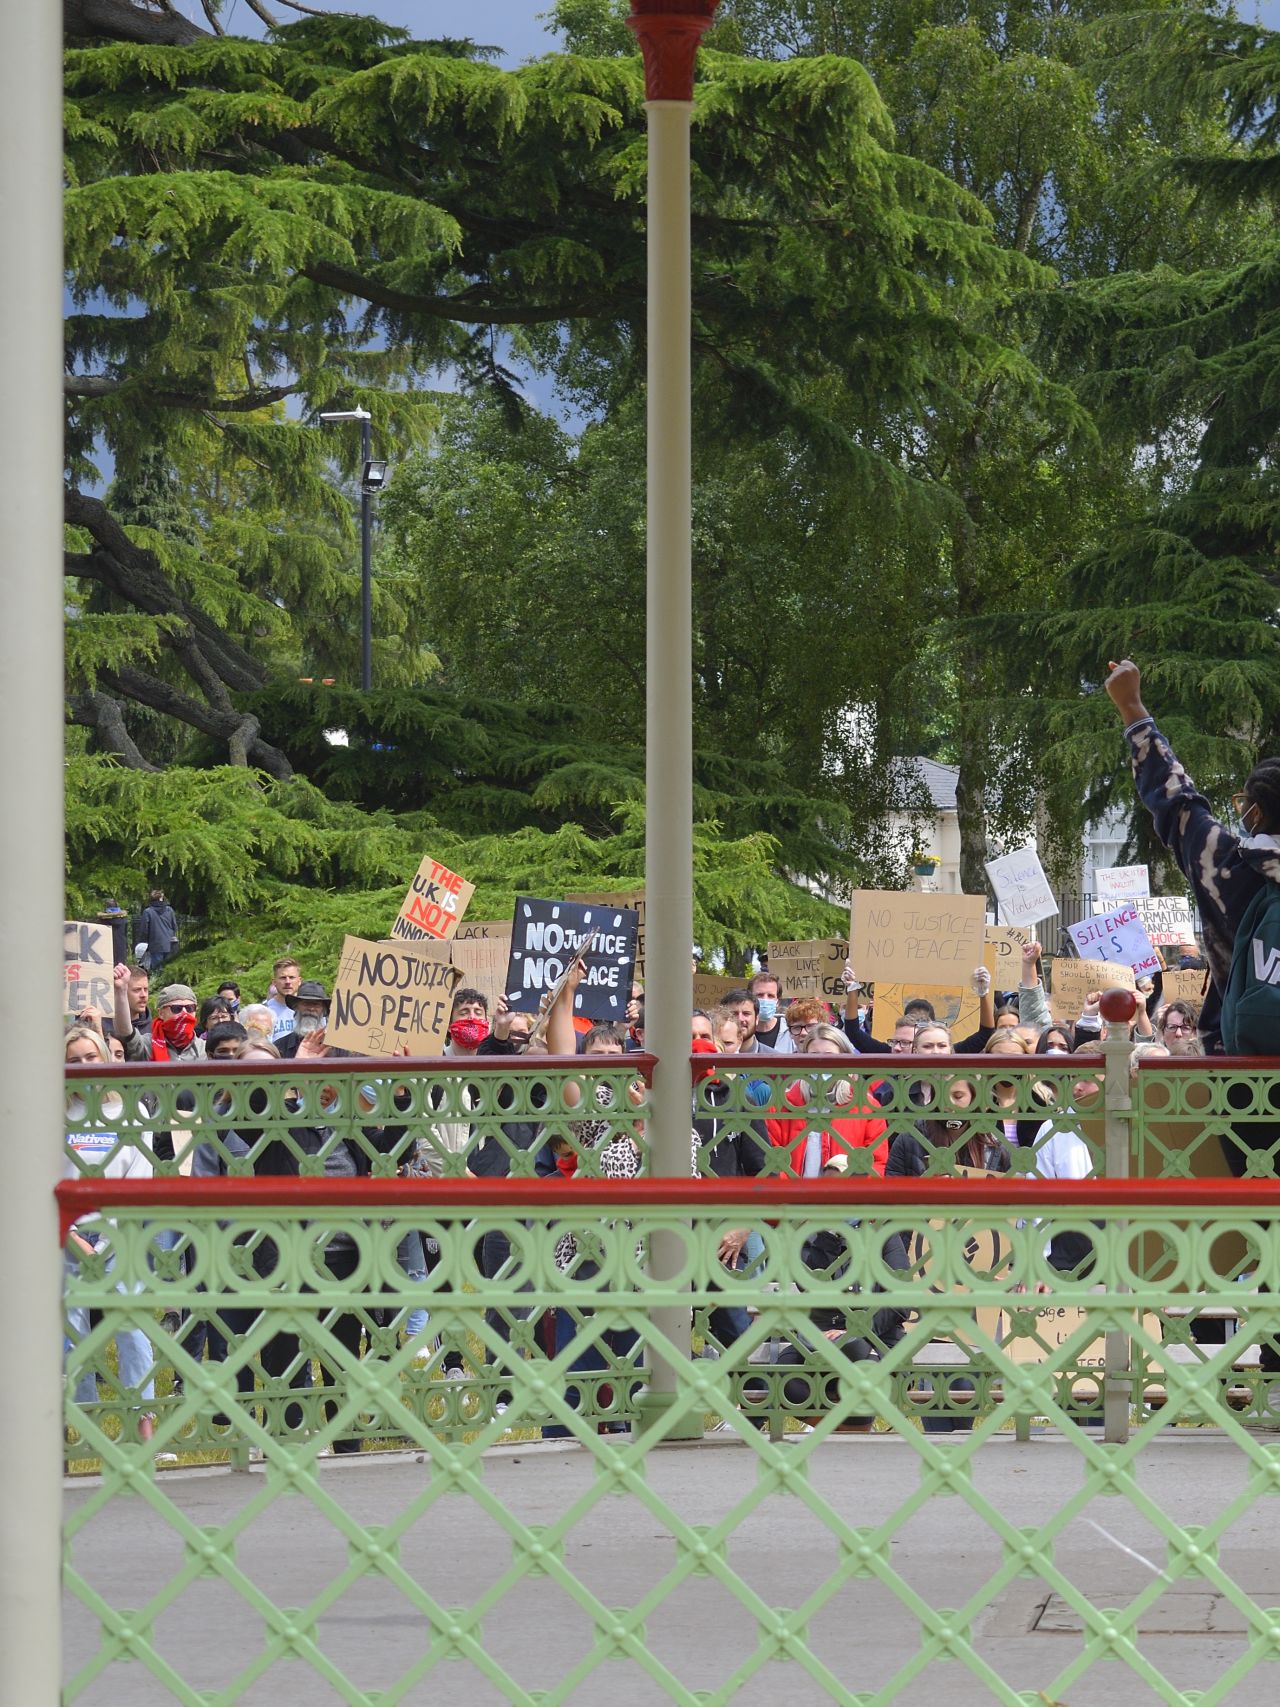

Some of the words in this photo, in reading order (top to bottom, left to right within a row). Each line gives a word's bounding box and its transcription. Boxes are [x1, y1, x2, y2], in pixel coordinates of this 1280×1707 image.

[431, 861, 465, 896] THE
[412, 875, 441, 905] U.K.
[440, 891, 459, 913] IS
[1102, 900, 1119, 913] IN
[1157, 898, 1182, 911] AGE
[409, 896, 457, 934] NOT
[867, 909, 892, 928] NO
[903, 911, 980, 934] JUSTICE
[454, 926, 489, 940] LACK
[525, 922, 564, 954] NO
[1077, 911, 1137, 945] SILENCE
[772, 944, 800, 960] BLACK
[867, 939, 895, 960] NO
[904, 937, 973, 961] PEACE
[1097, 935, 1123, 961] IS
[523, 957, 564, 989] NO
[1060, 962, 1078, 971] OUR
[1084, 964, 1107, 973] SKIN
[1060, 971, 1091, 979] SHOULD
[335, 988, 371, 1031] NO
[381, 994, 446, 1035] PEACE
[67, 1133, 117, 1145] Natives
